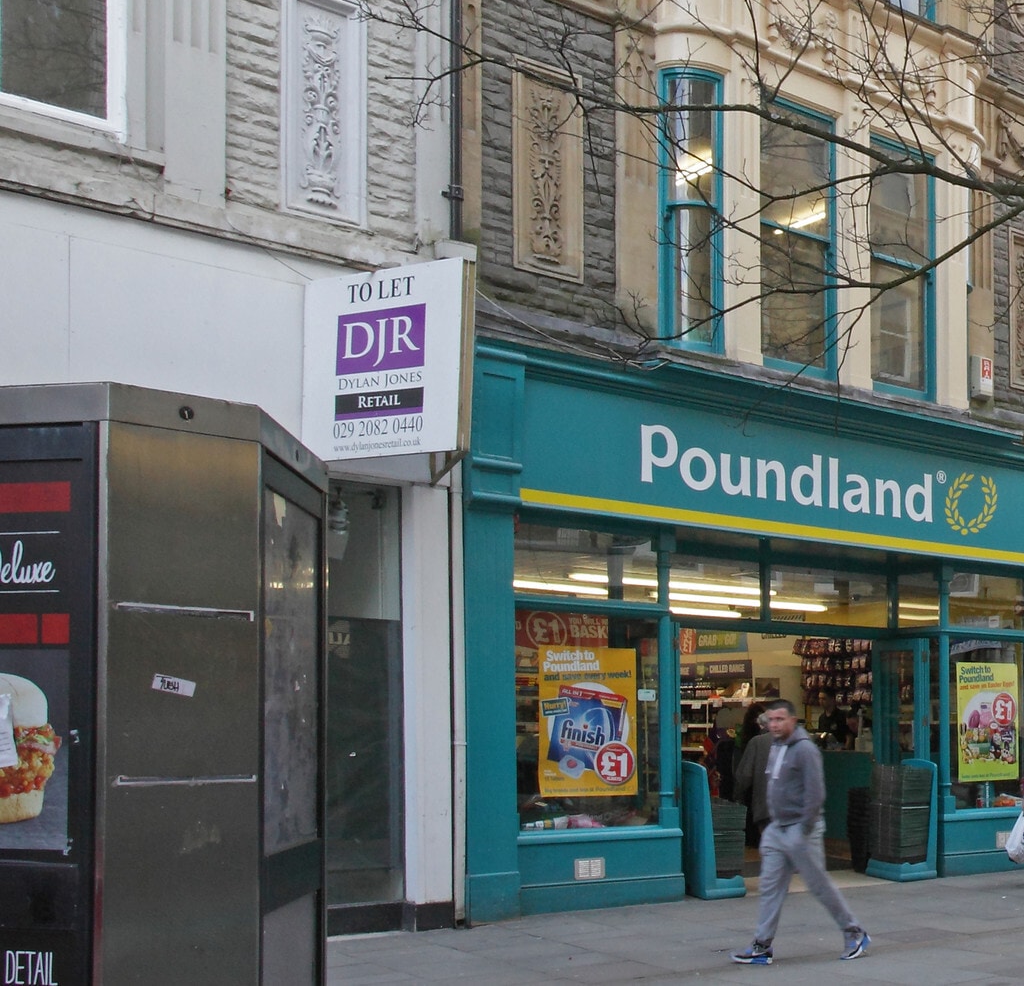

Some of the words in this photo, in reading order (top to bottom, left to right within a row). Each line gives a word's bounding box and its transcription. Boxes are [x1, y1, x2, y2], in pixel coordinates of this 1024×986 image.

[347, 281, 373, 304] TO
[378, 275, 415, 300] LET
[341, 315, 421, 367] DJR
[338, 375, 380, 391] DYLAN
[384, 371, 423, 389] JONES
[357, 393, 401, 409] RETAIL
[333, 421, 355, 440] 029
[358, 418, 388, 438] 2082
[392, 415, 424, 434] 0440
[333, 436, 421, 454] www.dylanjonesretail.co.uk
[640, 423, 933, 523] Poundland
[0, 540, 56, 584] eluxe
[533, 618, 561, 643] £1
[570, 624, 609, 639] BASK
[543, 660, 600, 673] Poundland
[546, 650, 583, 662] Switch
[584, 650, 595, 661] to
[543, 672, 560, 682] and
[583, 671, 607, 682] every
[607, 670, 632, 679] week!
[959, 673, 994, 684] Poundland
[961, 666, 984, 676] Switch
[984, 665, 992, 674] to
[994, 699, 1013, 721] £1
[561, 719, 606, 746] finish
[600, 751, 628, 778] £1
[5, 950, 58, 986] DETAIL
